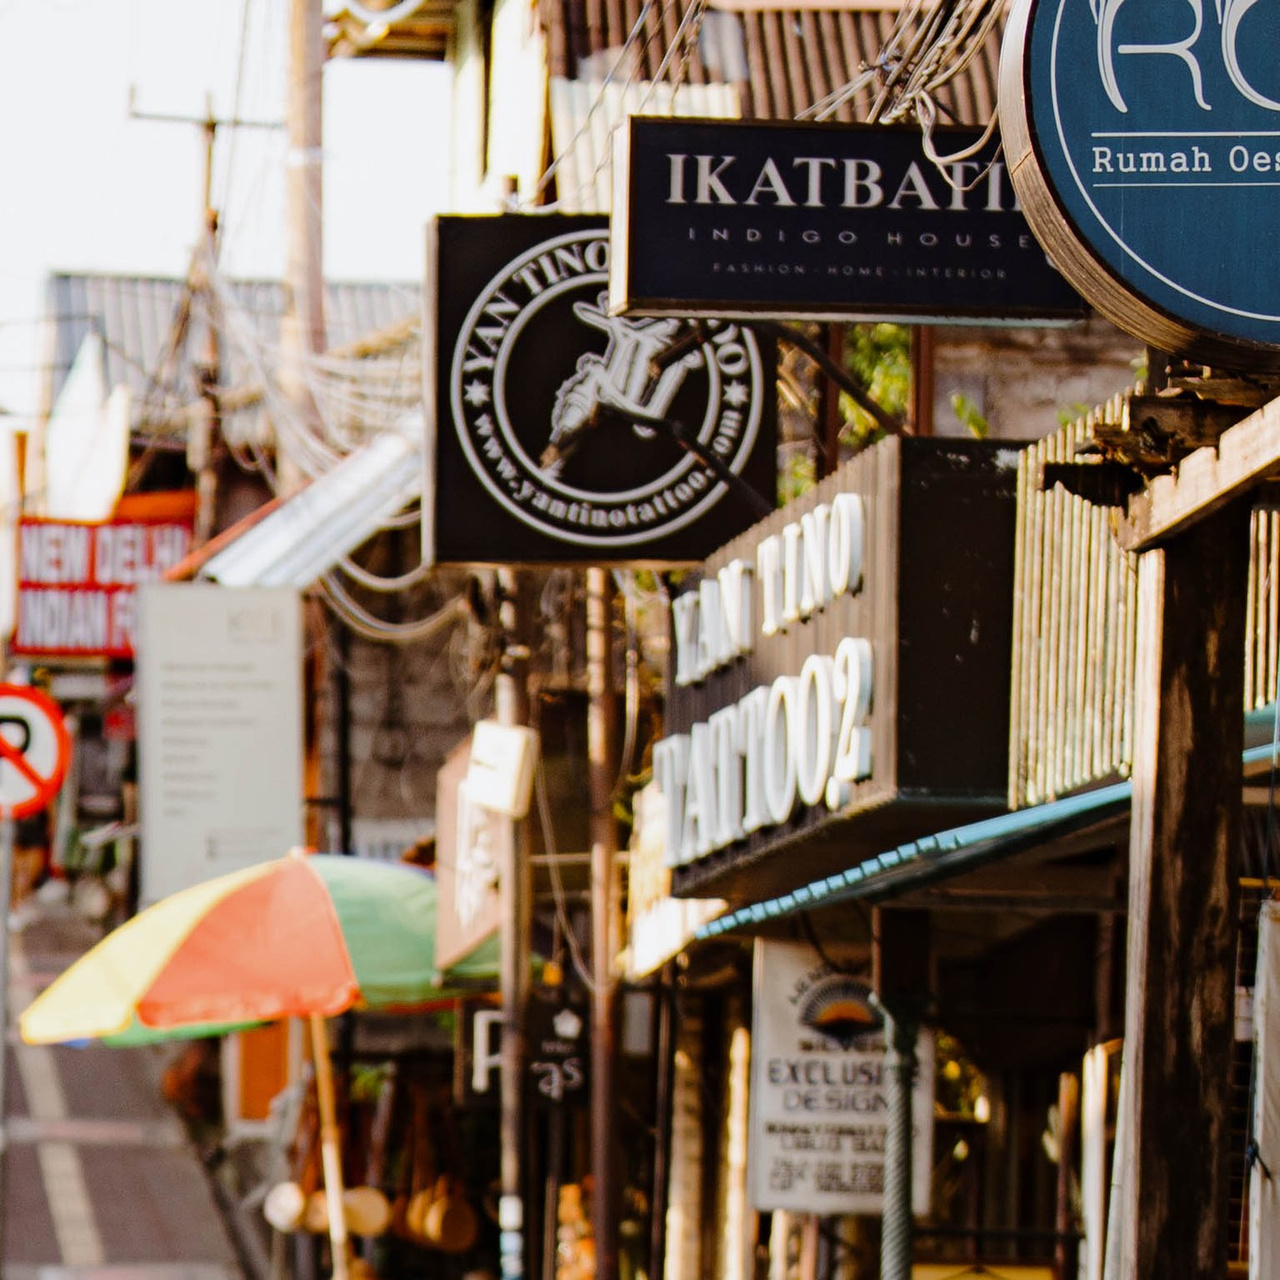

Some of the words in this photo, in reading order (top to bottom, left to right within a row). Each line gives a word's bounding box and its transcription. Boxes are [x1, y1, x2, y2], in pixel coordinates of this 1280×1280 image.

[665, 153, 1023, 212] IKATBATI
[1091, 146, 1213, 173] Rumah
[688, 227, 859, 245] INDIGO
[887, 232, 1030, 249] HOUSE
[712, 262, 805, 275] FASHION
[827, 265, 884, 277] HOME
[905, 267, 1007, 280] INTERIOR
[461, 291, 521, 373] YAN
[474, 408, 743, 528] www.yantinotattoo.om
[21, 524, 89, 583] NEW
[672, 558, 754, 686] YAN
[757, 492, 864, 637] TINO
